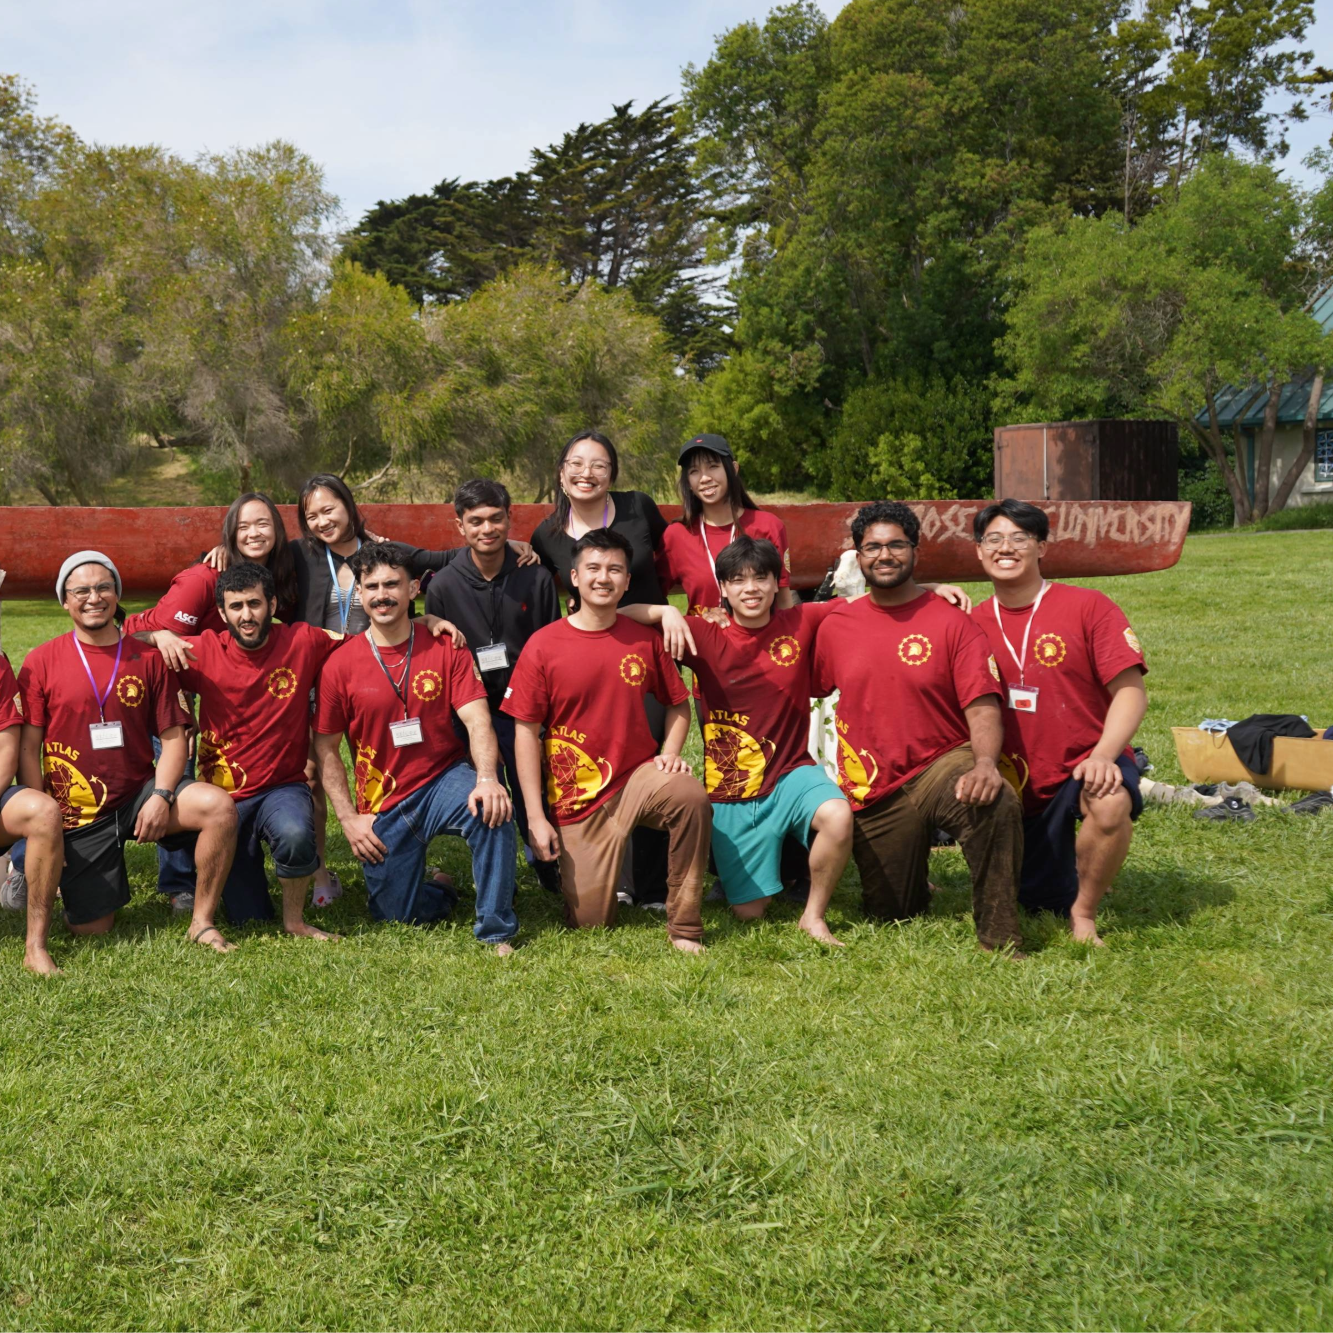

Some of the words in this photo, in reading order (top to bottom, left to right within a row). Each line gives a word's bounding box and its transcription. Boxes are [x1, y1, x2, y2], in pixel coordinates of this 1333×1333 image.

[1056, 501, 1191, 545] UNIVERSITY
[174, 610, 198, 624] ASCE
[710, 709, 750, 727] ATLAS
[551, 725, 587, 744] ATLAS
[46, 741, 80, 762] ATLAS
